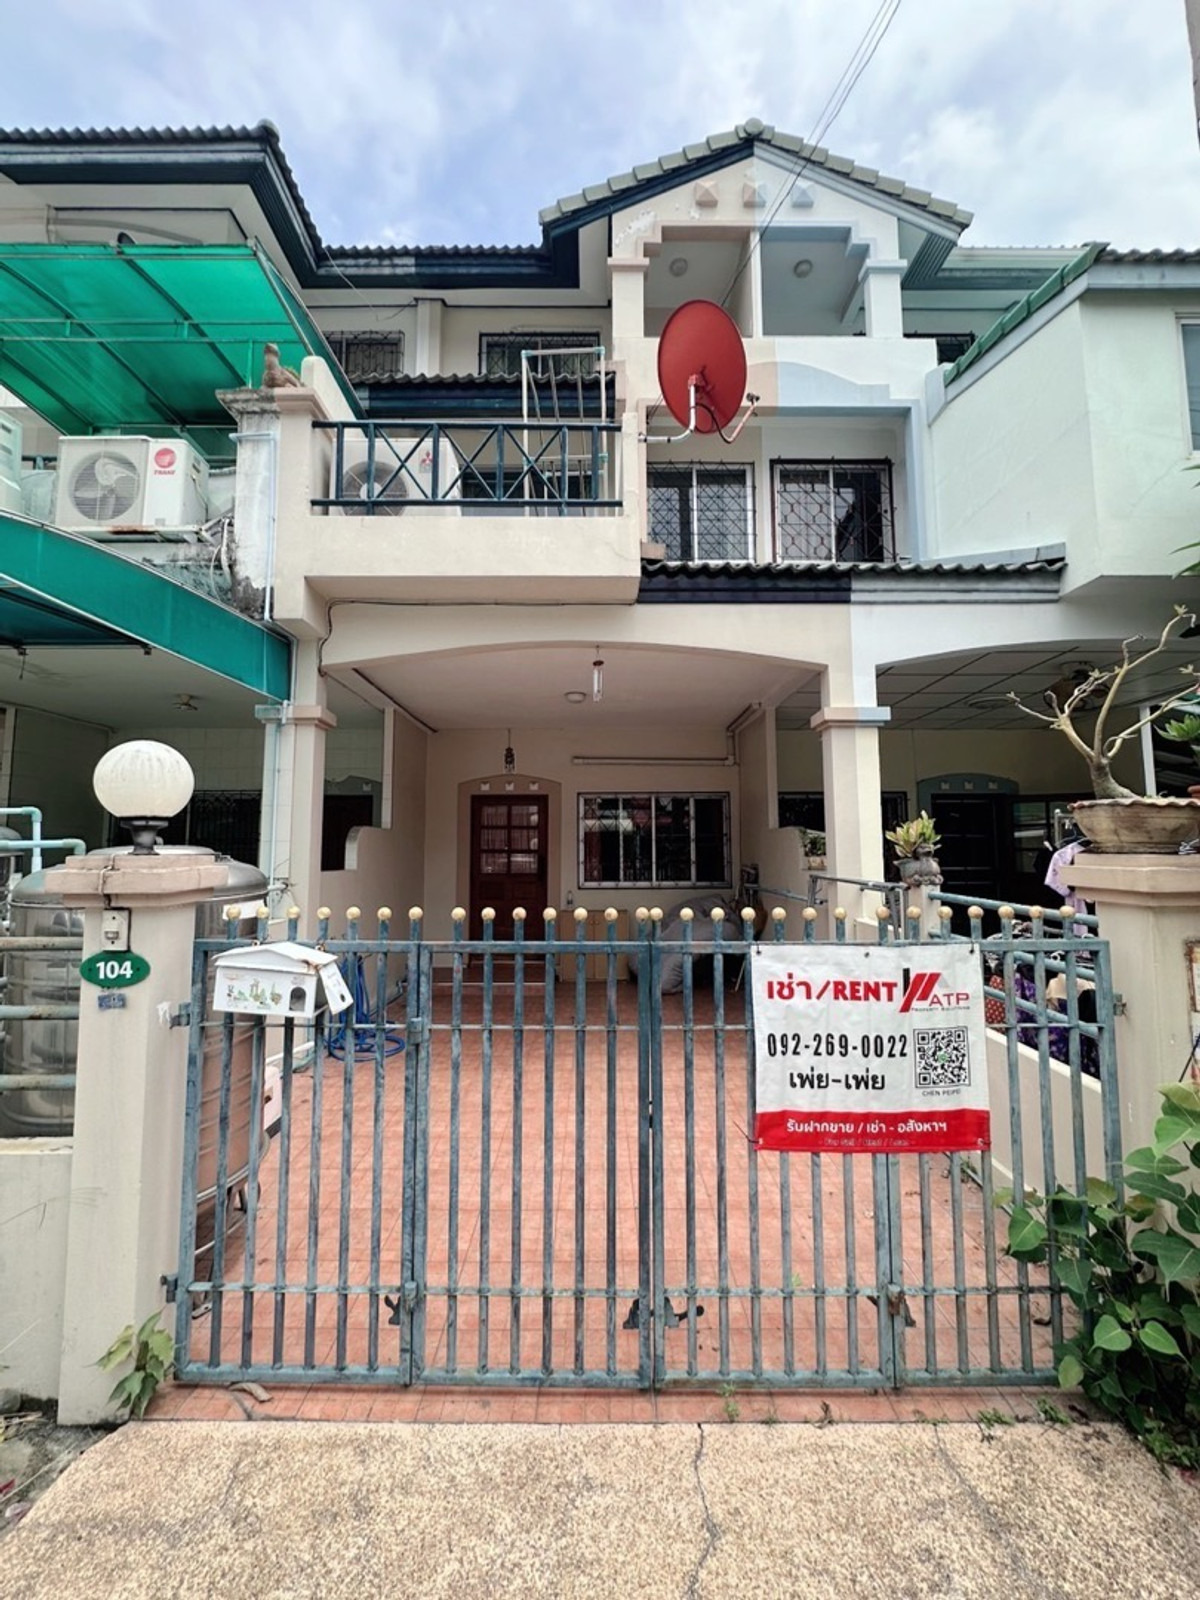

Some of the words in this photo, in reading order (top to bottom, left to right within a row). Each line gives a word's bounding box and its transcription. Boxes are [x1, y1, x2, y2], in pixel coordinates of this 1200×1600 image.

[96, 960, 133, 979] 104
[929, 992, 970, 1007] ATP
[767, 1032, 908, 1058] 092-269-0022
[789, 1066, 886, 1090] เพ่ย-เพ่ย
[787, 1119, 855, 1134] รับฝากขาย
[866, 1120, 887, 1133] เช่า
[897, 1119, 948, 1133] อสังหาฯ
